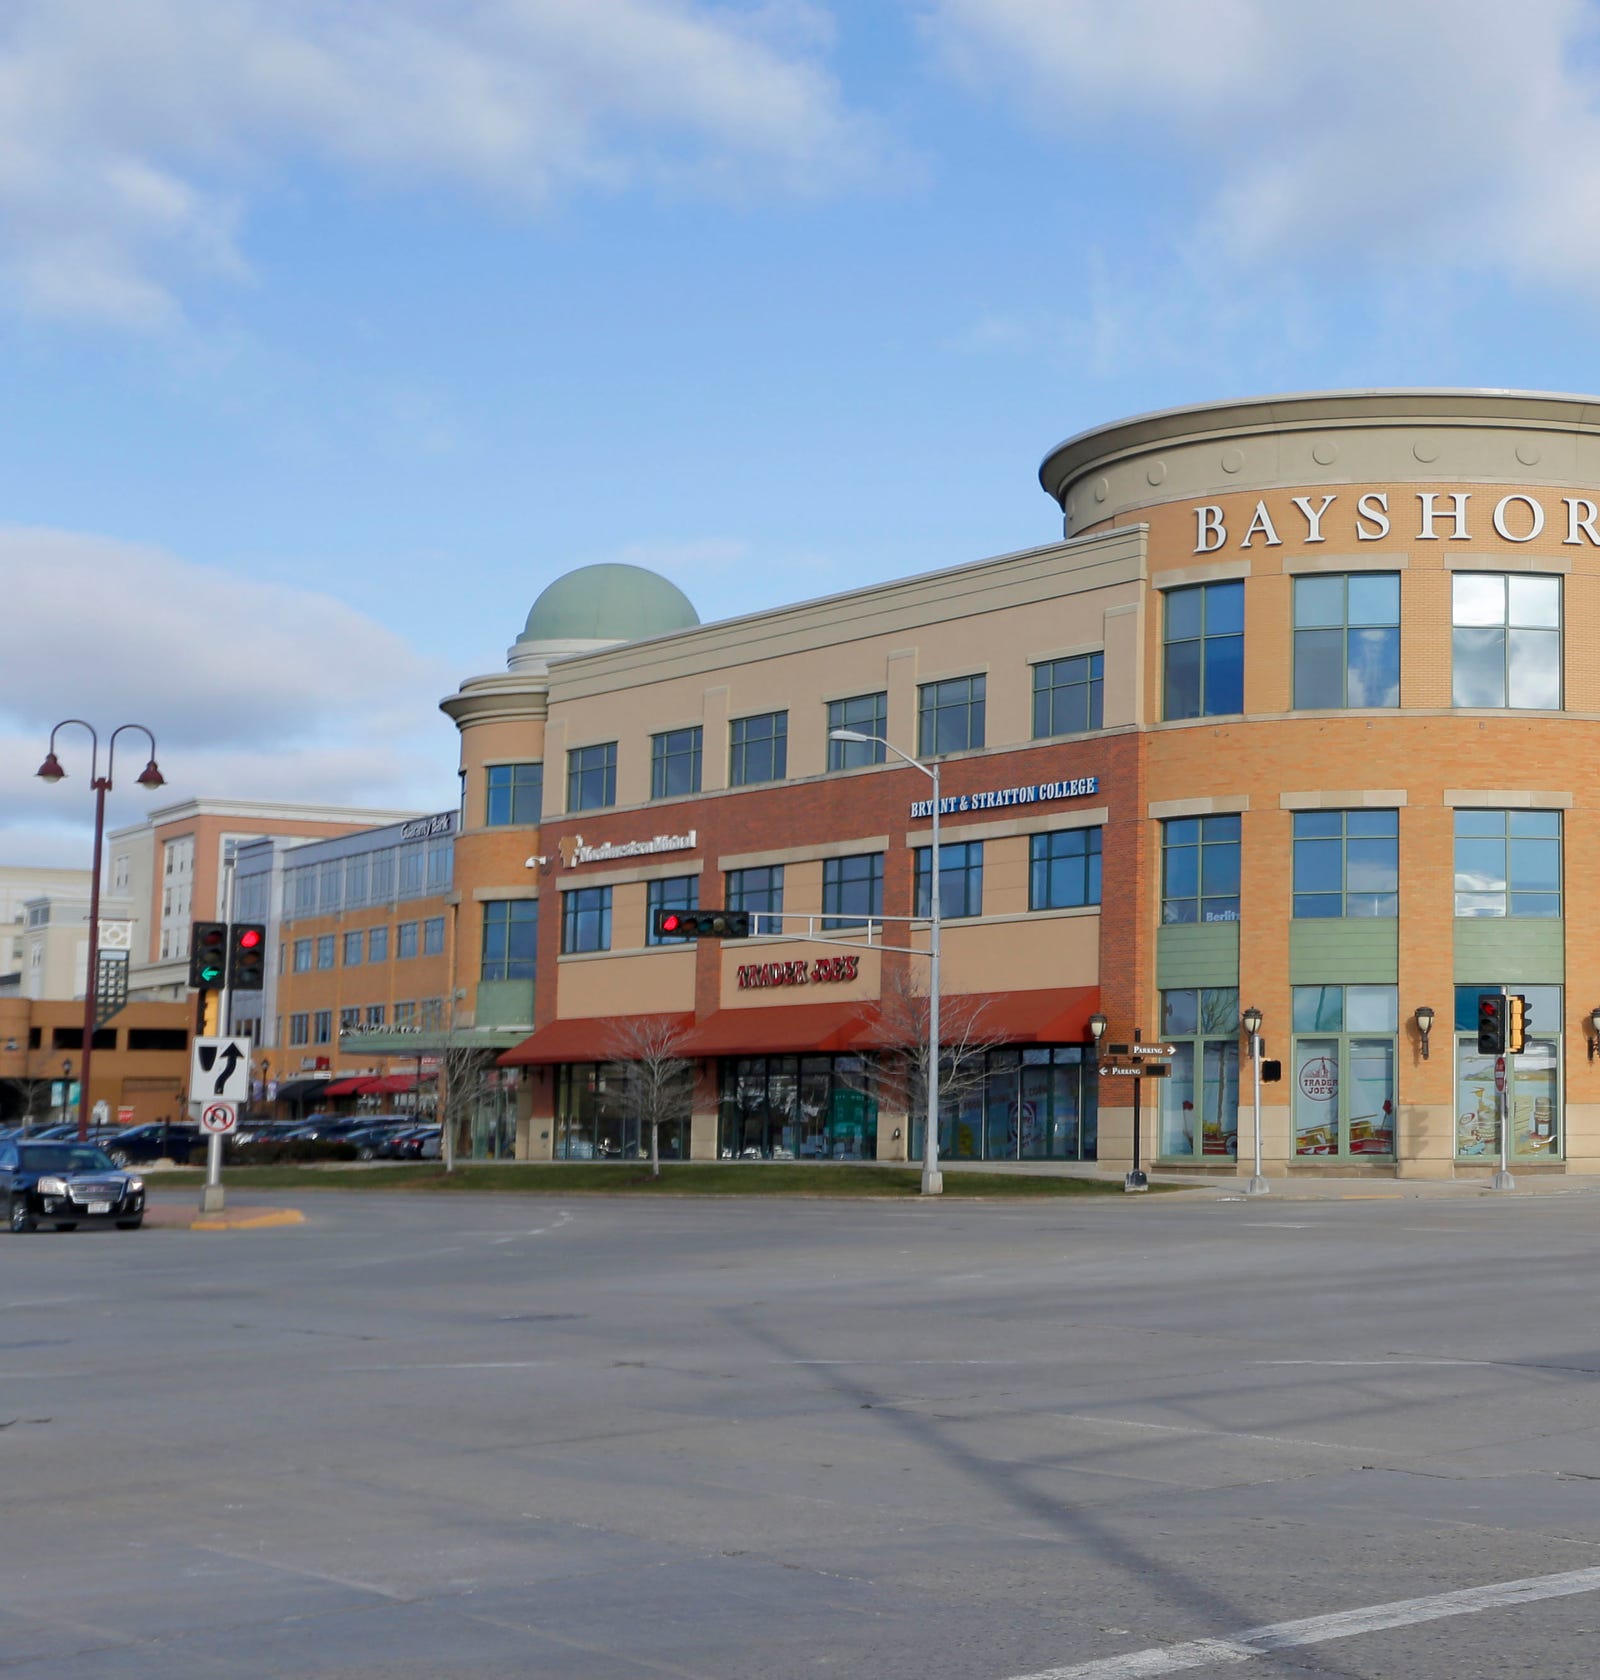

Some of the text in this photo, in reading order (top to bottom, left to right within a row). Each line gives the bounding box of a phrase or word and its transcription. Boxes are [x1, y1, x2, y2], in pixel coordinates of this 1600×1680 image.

[911, 777, 1097, 818] BRYNT & STRATTON COLLEGE
[737, 955, 860, 988] TRADER JOE'S
[1304, 1079, 1338, 1087] TRADER
[1308, 1086, 1334, 1095] JOE'S
